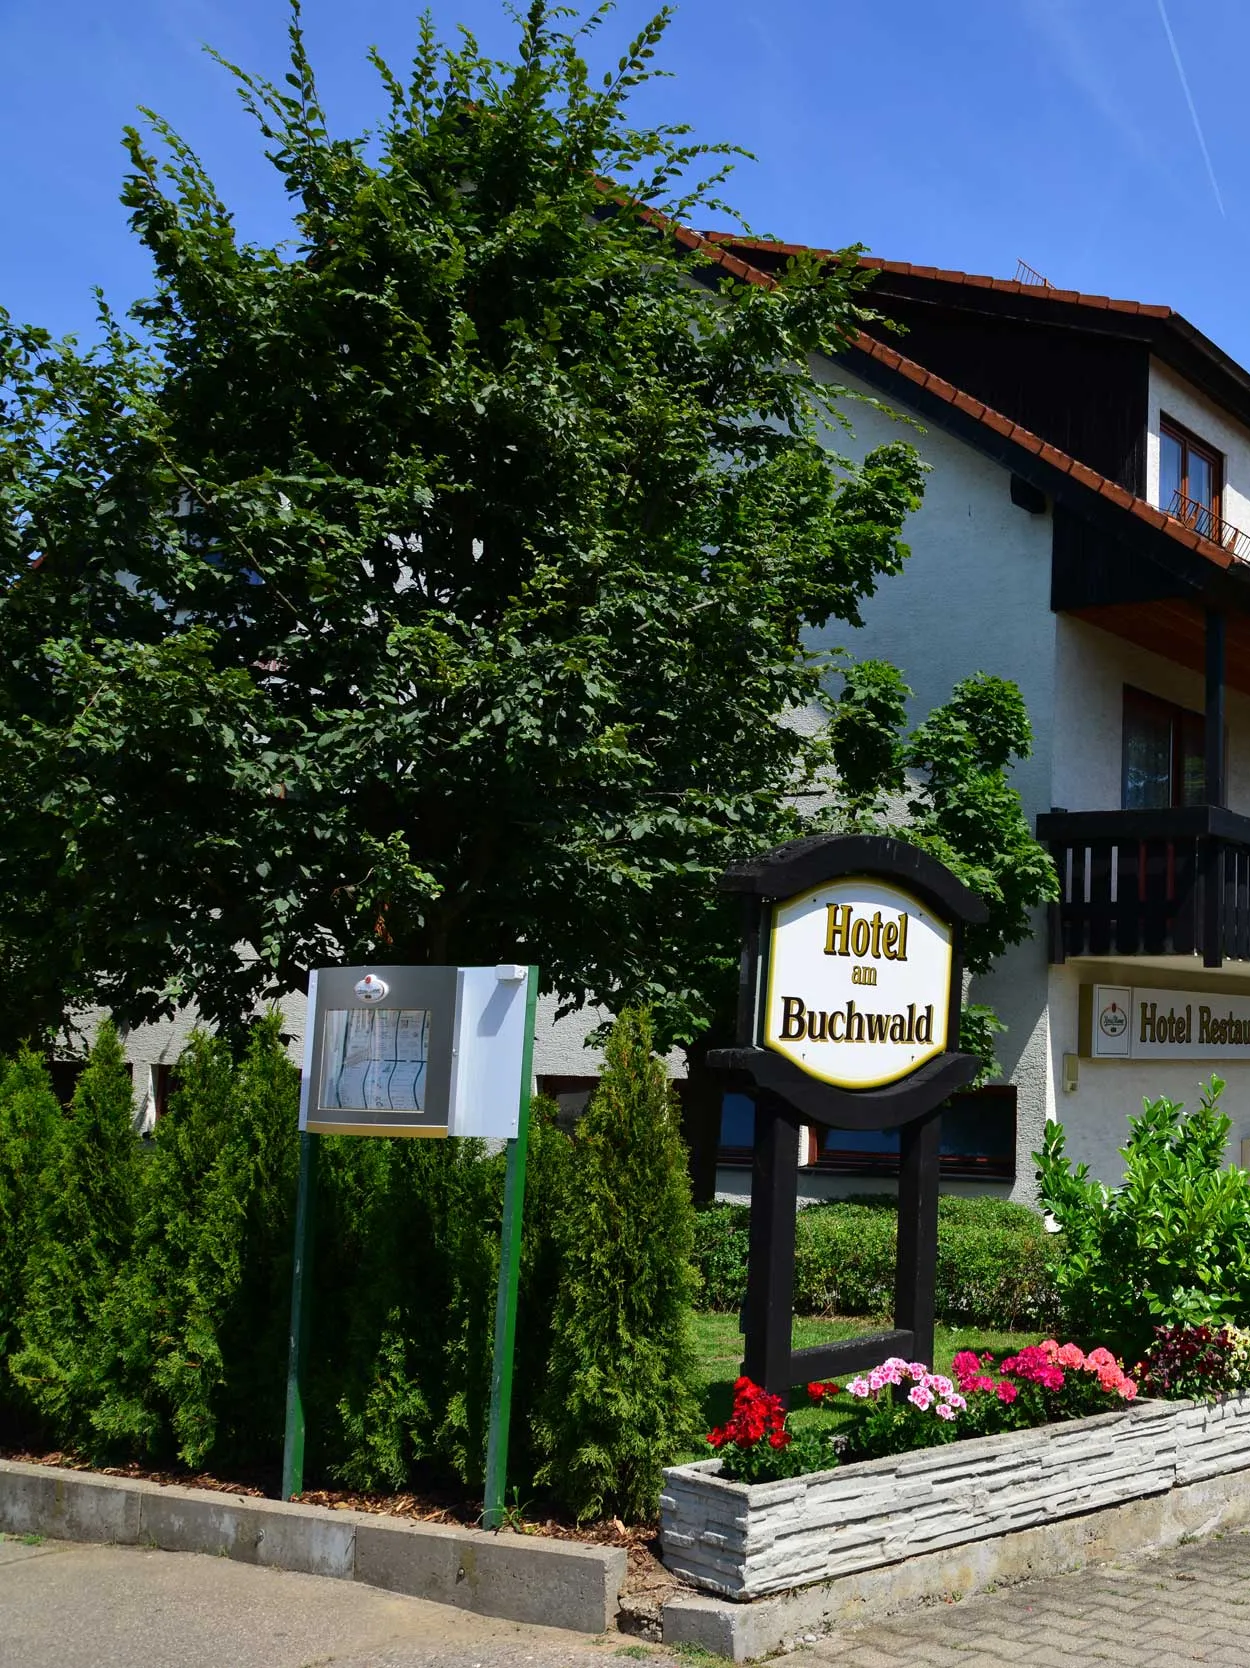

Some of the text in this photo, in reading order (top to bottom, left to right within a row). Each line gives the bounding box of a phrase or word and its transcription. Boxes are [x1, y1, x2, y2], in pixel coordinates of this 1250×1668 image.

[823, 902, 908, 962] Hotel
[851, 964, 878, 986] am
[778, 996, 934, 1046] Buchwald
[1139, 1002, 1192, 1044] Hotel
